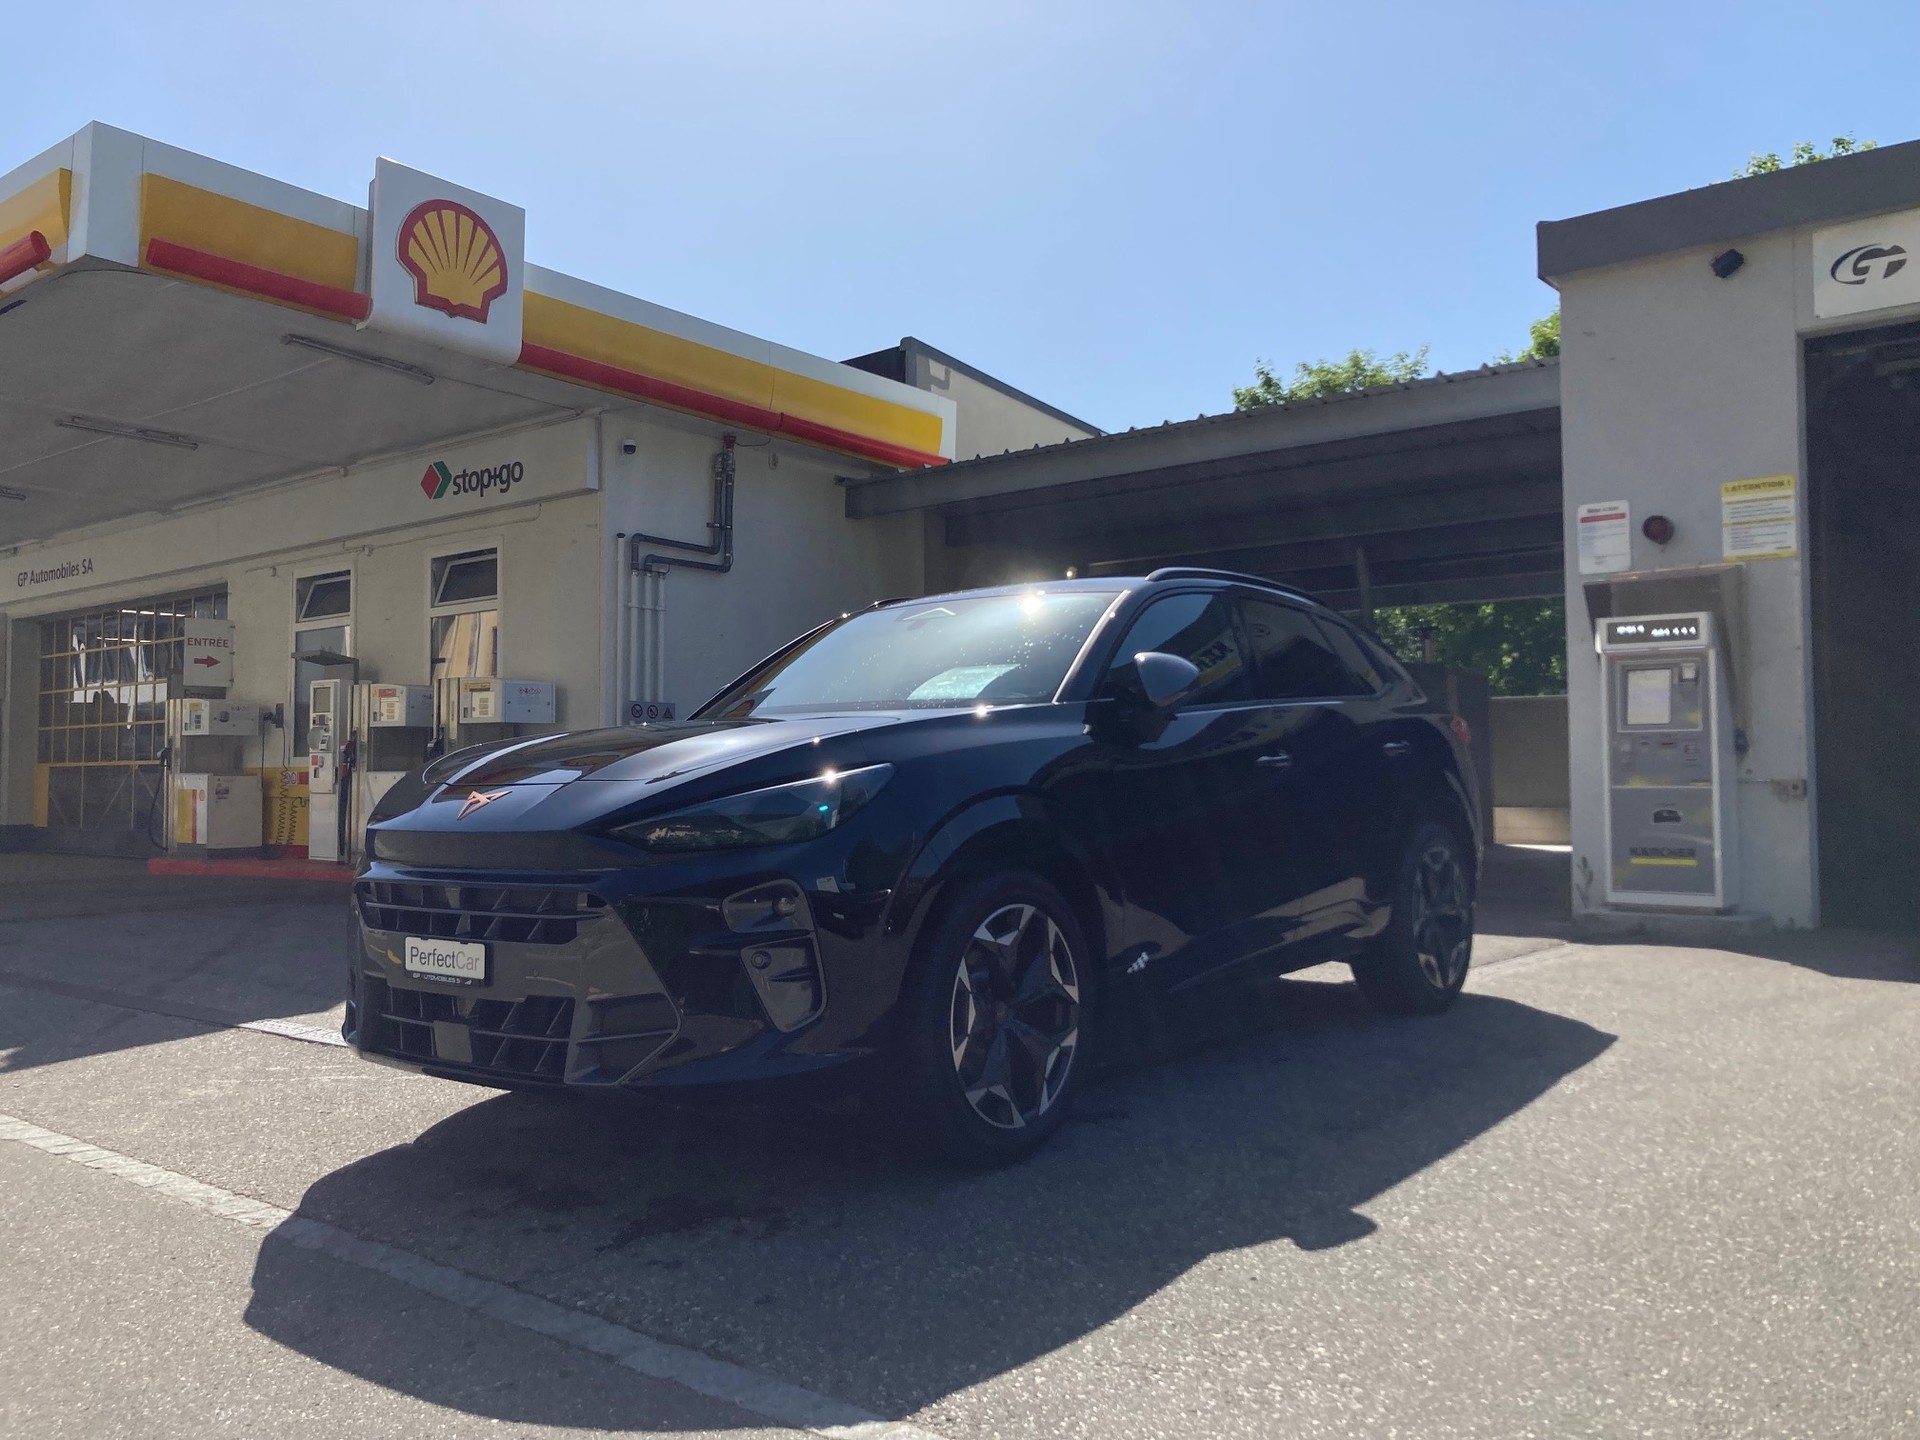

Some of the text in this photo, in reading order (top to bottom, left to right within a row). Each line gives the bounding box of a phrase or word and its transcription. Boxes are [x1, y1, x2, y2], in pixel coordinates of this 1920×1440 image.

[453, 461, 524, 497] stop+go
[17, 558, 93, 587] GP Automobiles SA
[187, 636, 229, 648] ENTRÉE
[410, 946, 480, 971] PerfectCar
